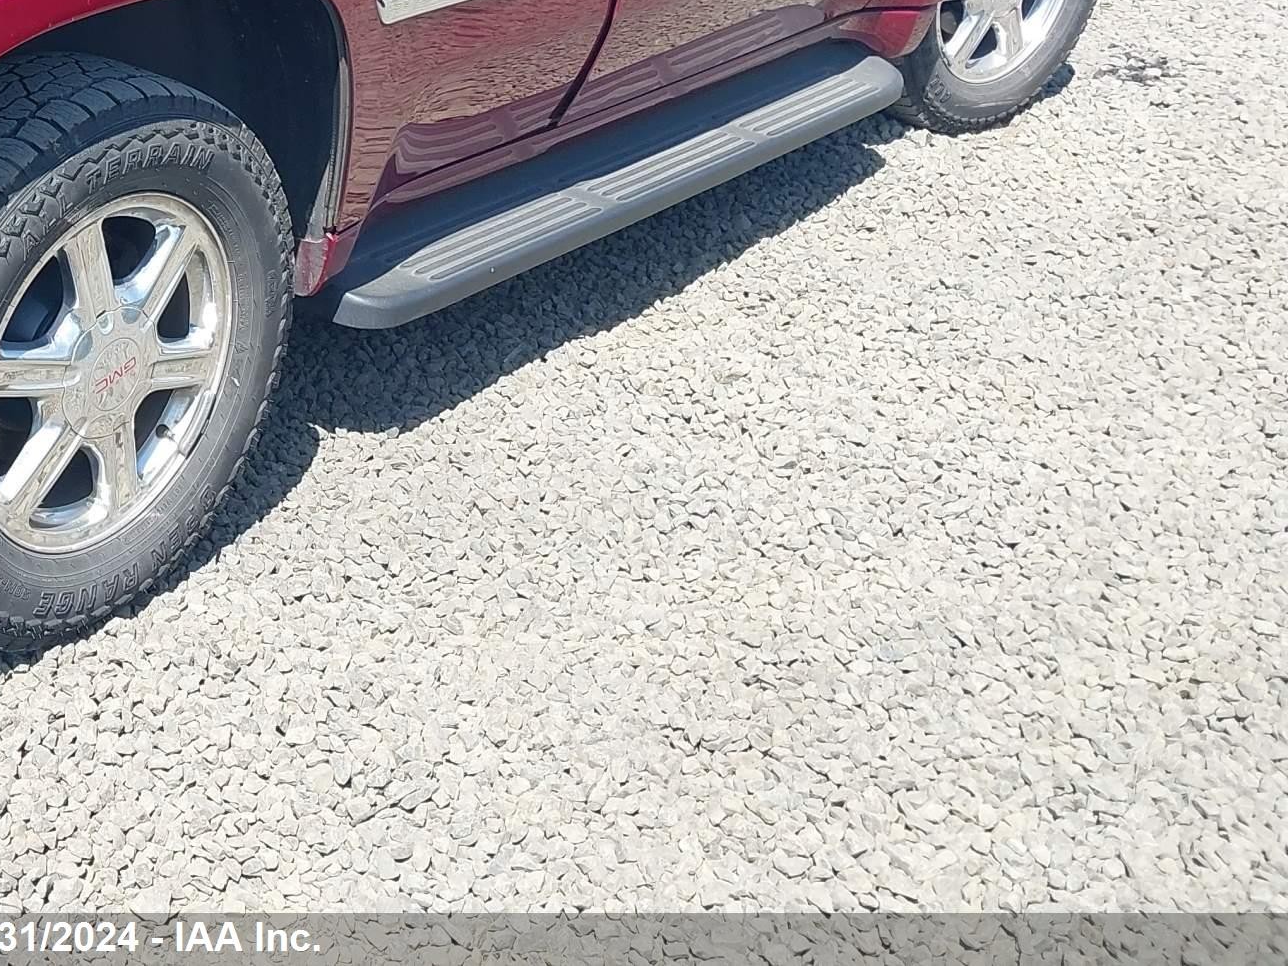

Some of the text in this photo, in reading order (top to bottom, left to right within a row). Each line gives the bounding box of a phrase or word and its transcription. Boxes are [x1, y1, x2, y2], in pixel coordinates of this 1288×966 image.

[23, 141, 215, 262] ALL TERRAIN
[94, 356, 137, 395] GMC
[32, 559, 143, 619] RANGE
